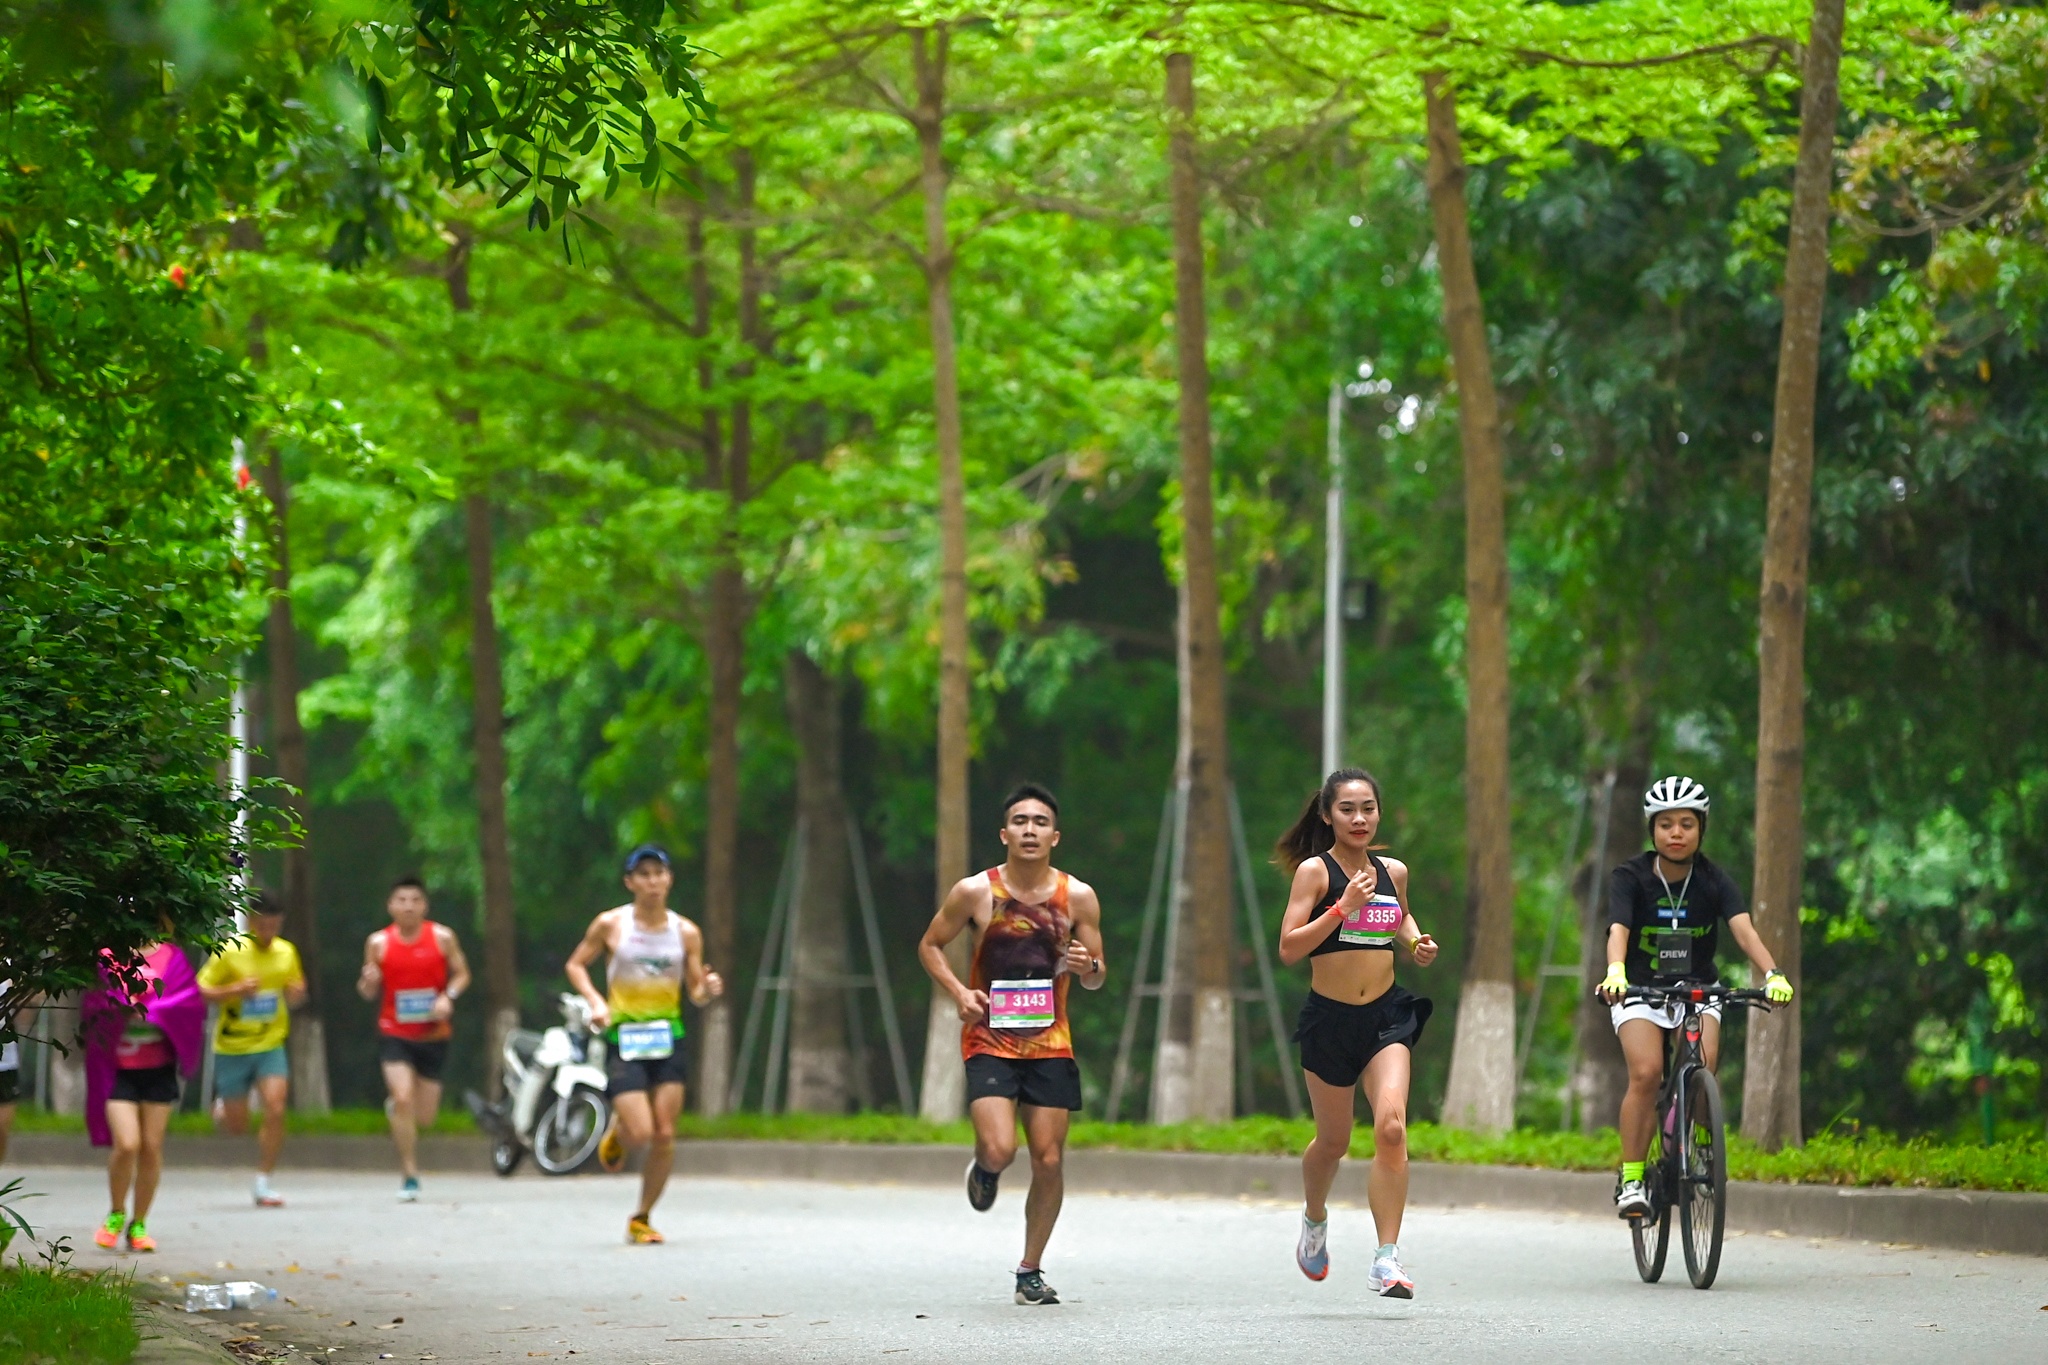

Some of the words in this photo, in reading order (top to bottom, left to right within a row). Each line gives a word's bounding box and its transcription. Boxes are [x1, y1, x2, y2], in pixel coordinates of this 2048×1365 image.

[1366, 909, 1396, 923] 3355
[1660, 950, 1688, 959] CREW
[1012, 993, 1046, 1007] 3143
